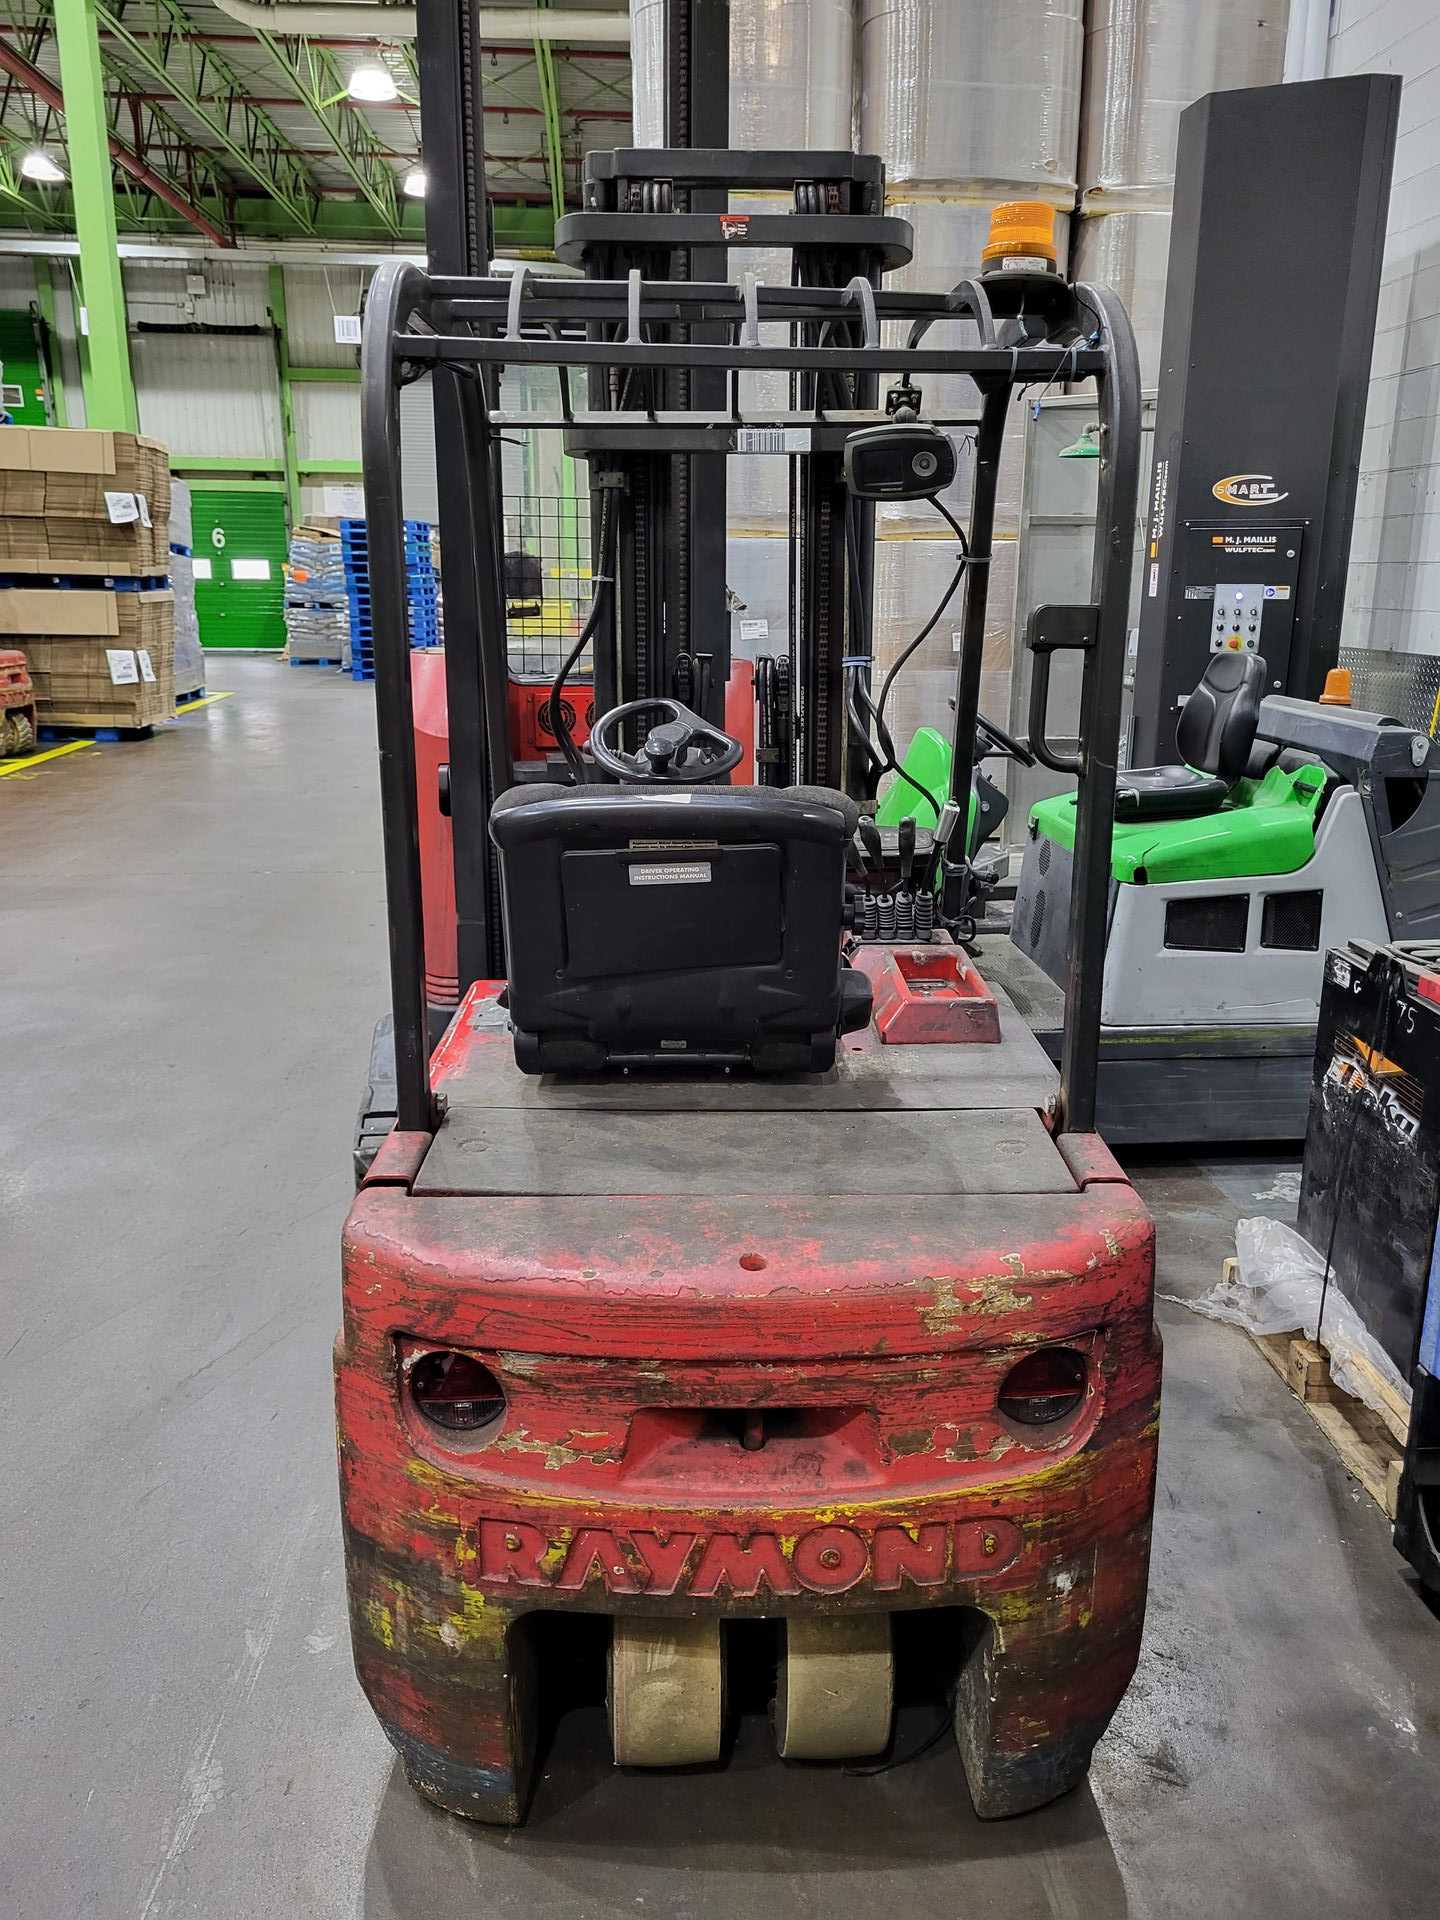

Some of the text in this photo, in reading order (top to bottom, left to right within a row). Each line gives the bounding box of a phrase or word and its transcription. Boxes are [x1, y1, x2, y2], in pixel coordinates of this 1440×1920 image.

[1154, 461, 1163, 511] MAILLIS
[1215, 483, 1276, 496] SMART
[211, 527, 226, 549] 6
[1243, 536, 1277, 544] MAILLIS
[633, 872, 707, 881] INSTRUCTIONS MANUAL
[663, 866, 700, 874] OPERATING
[478, 1515, 1026, 1598] RAYMOND
